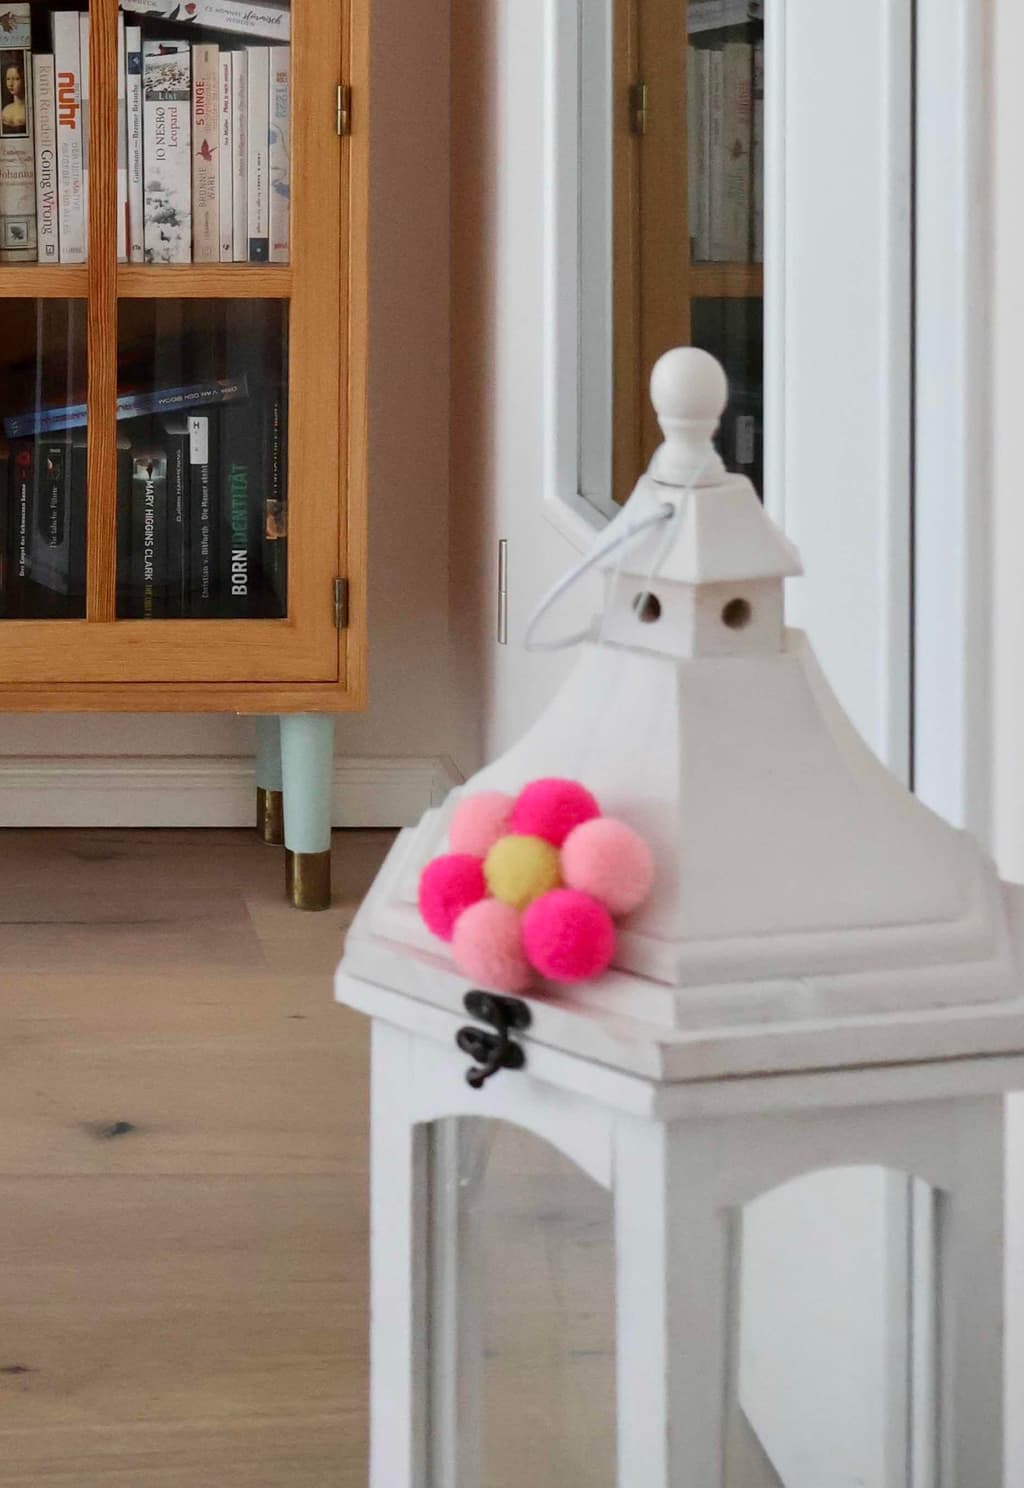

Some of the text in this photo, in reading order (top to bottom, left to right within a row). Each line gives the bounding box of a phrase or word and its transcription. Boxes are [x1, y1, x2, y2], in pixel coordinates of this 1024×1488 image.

[39, 98, 54, 147] Rendell
[57, 72, 80, 130] nuhr
[154, 106, 167, 161] JO NESBØ
[166, 107, 180, 148] Leopard
[39, 149, 54, 193] Going
[40, 190, 55, 235] Wrong
[201, 485, 209, 508] Mauer
[201, 508, 209, 521] Die
[144, 479, 154, 581] MARY HIGGINS CLARK
[228, 463, 248, 596] BORN IDENTITÄT
[200, 565, 209, 599] Christian
